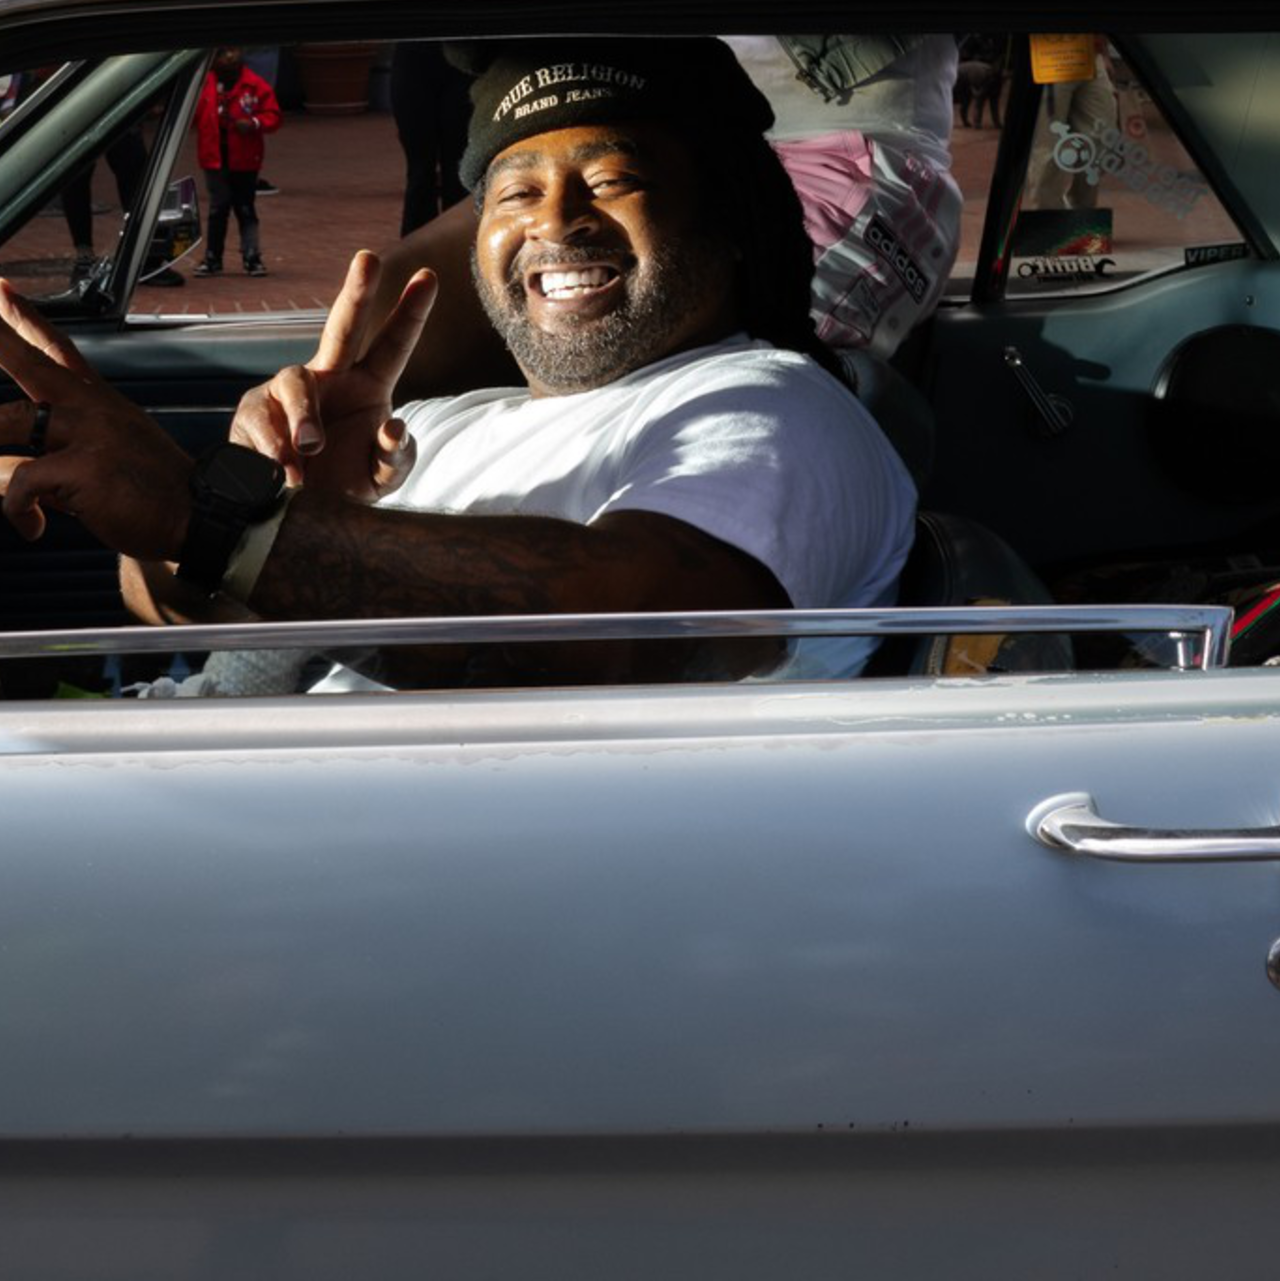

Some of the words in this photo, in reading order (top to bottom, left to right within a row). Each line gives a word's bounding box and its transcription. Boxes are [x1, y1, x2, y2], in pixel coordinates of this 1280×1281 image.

[492, 76, 533, 122] TRUE
[535, 63, 646, 90] RELIGION
[514, 95, 558, 119] BRAND
[566, 87, 614, 103] JEANS
[869, 225, 928, 299] adidas
[1186, 247, 1244, 264] VIPER
